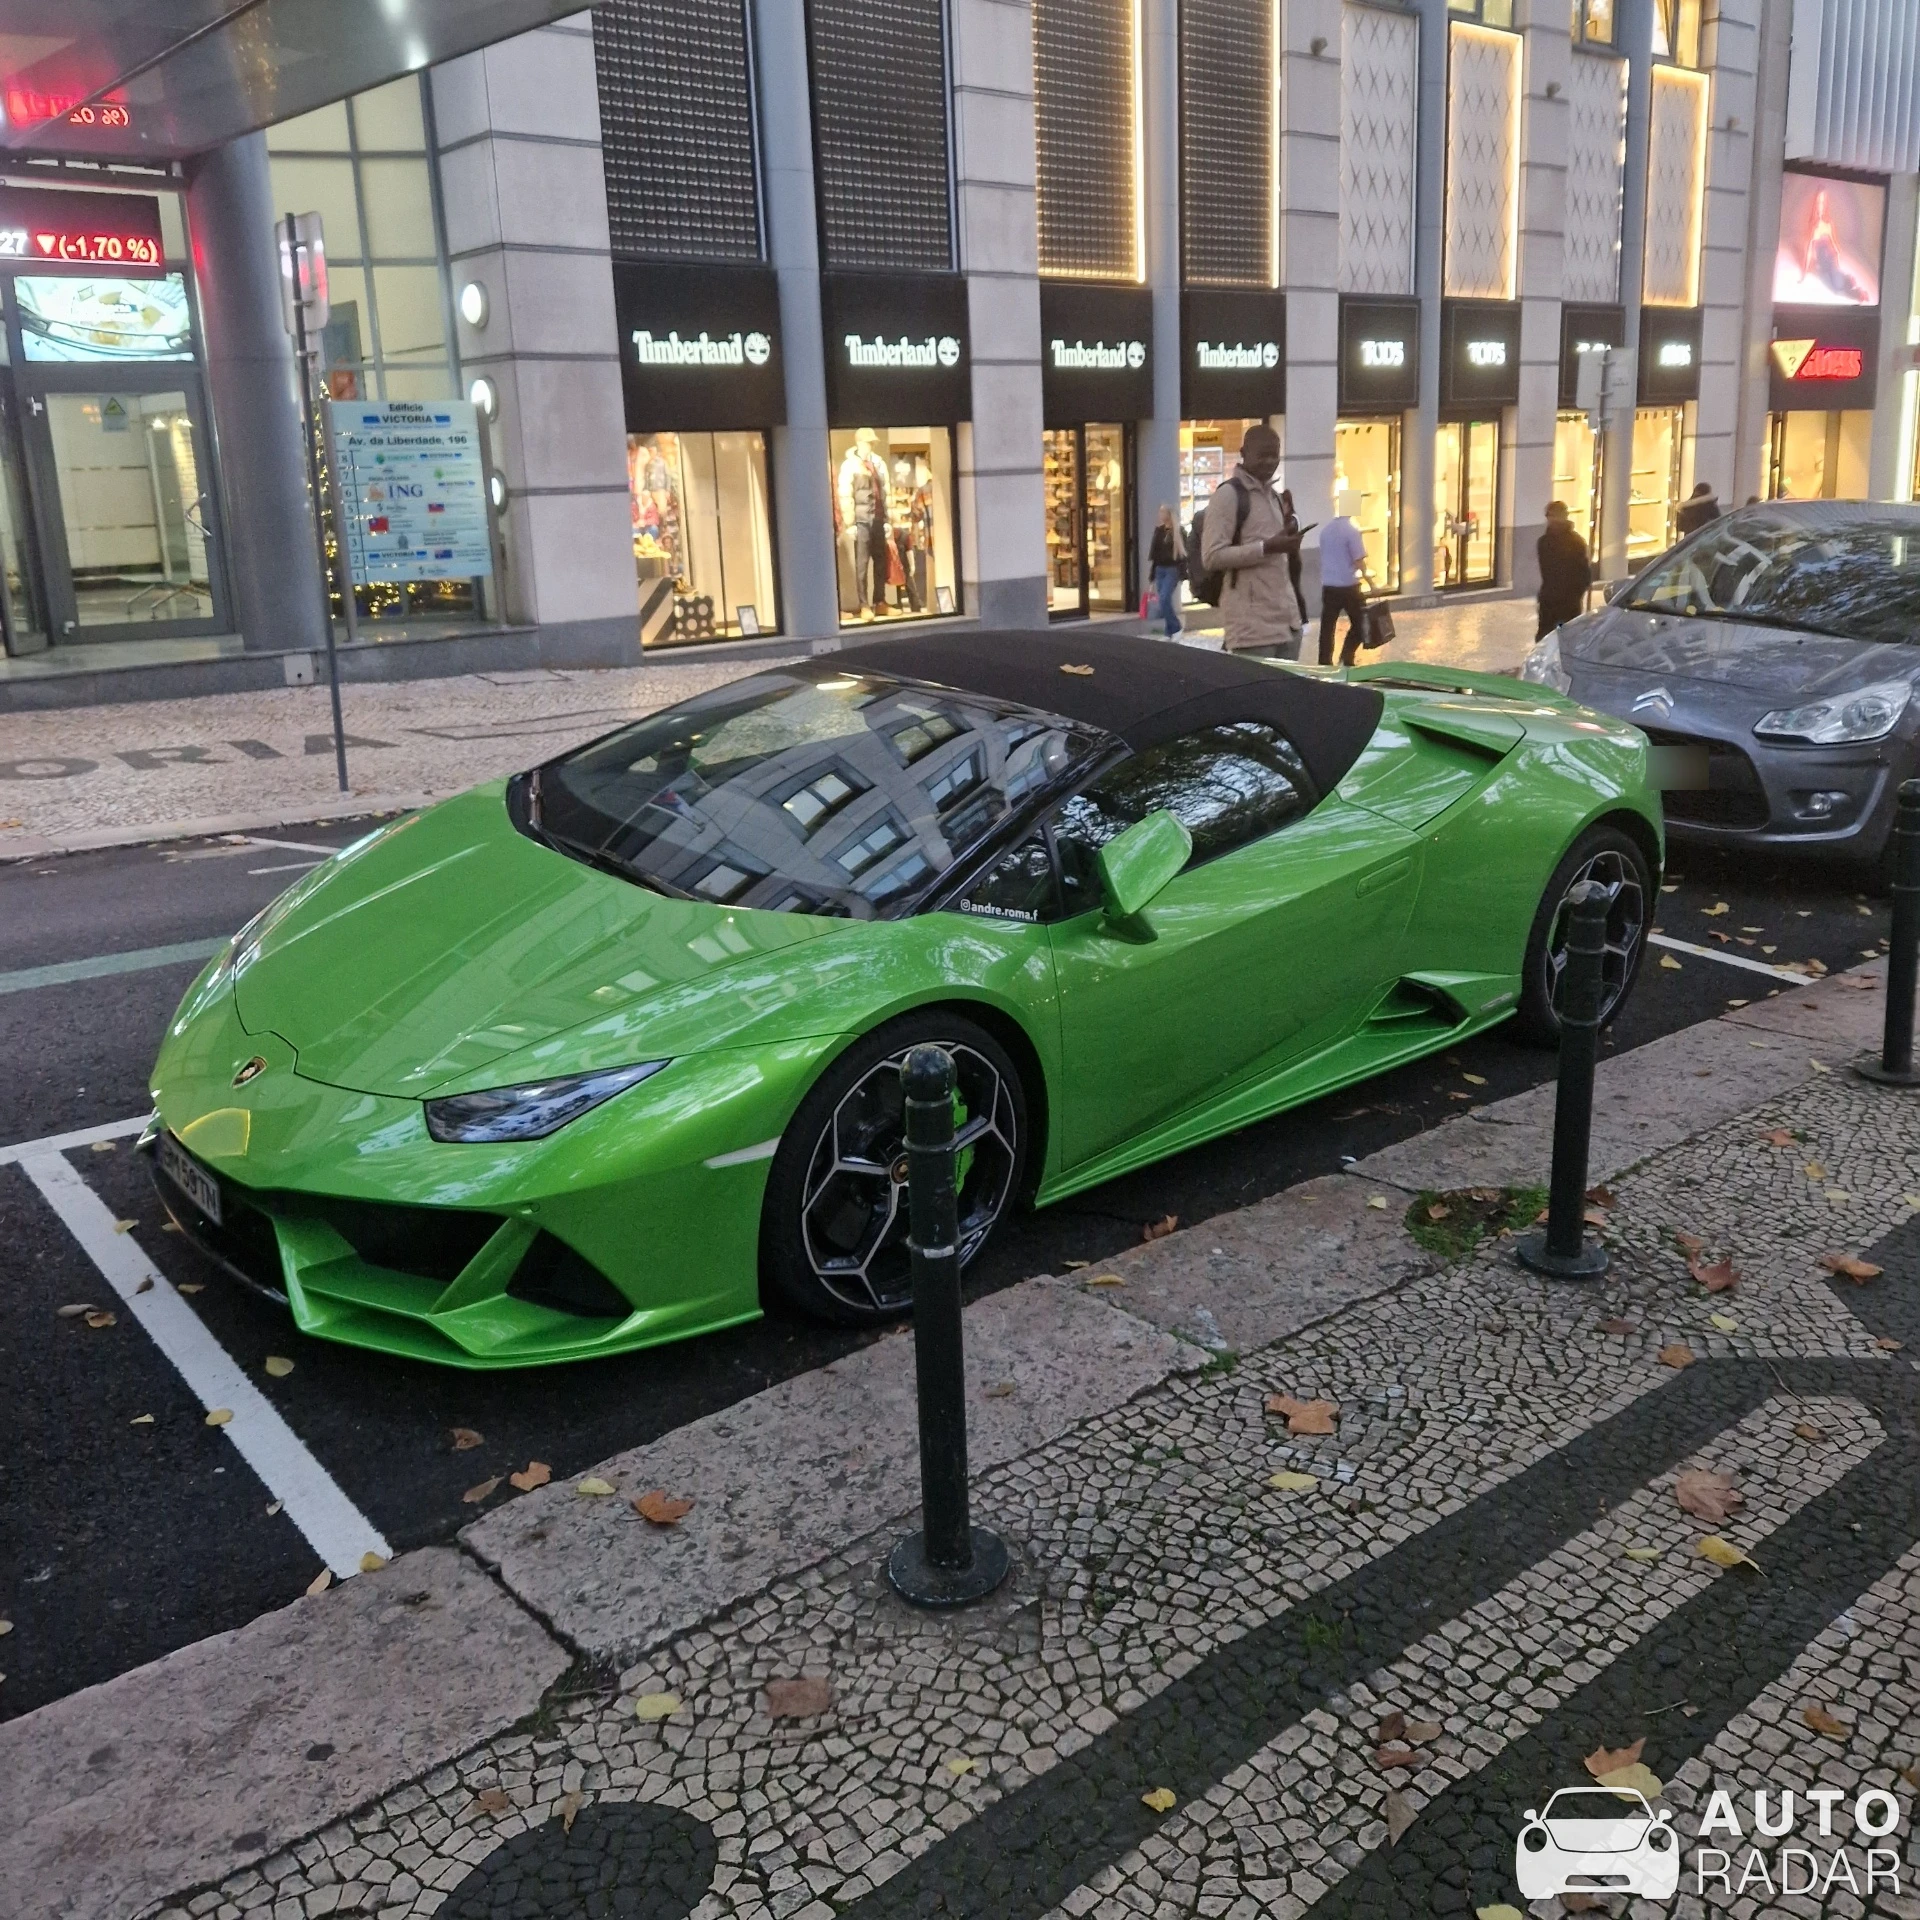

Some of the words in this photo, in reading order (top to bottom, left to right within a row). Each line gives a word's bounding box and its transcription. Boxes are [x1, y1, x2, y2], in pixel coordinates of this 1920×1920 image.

[59, 235, 123, 260] (-1,70
[127, 238, 158, 263] %)
[632, 330, 743, 364] Timberland
[845, 335, 937, 366] Timberland
[1051, 339, 1126, 367] Timberland
[1197, 341, 1262, 368] Timberland
[382, 415, 433, 424] VICTORIA
[349, 436, 367, 446] Av.
[370, 436, 383, 445] da
[387, 436, 445, 446] Liberdade,
[448, 435, 468, 444] 196
[389, 484, 423, 498] ING
